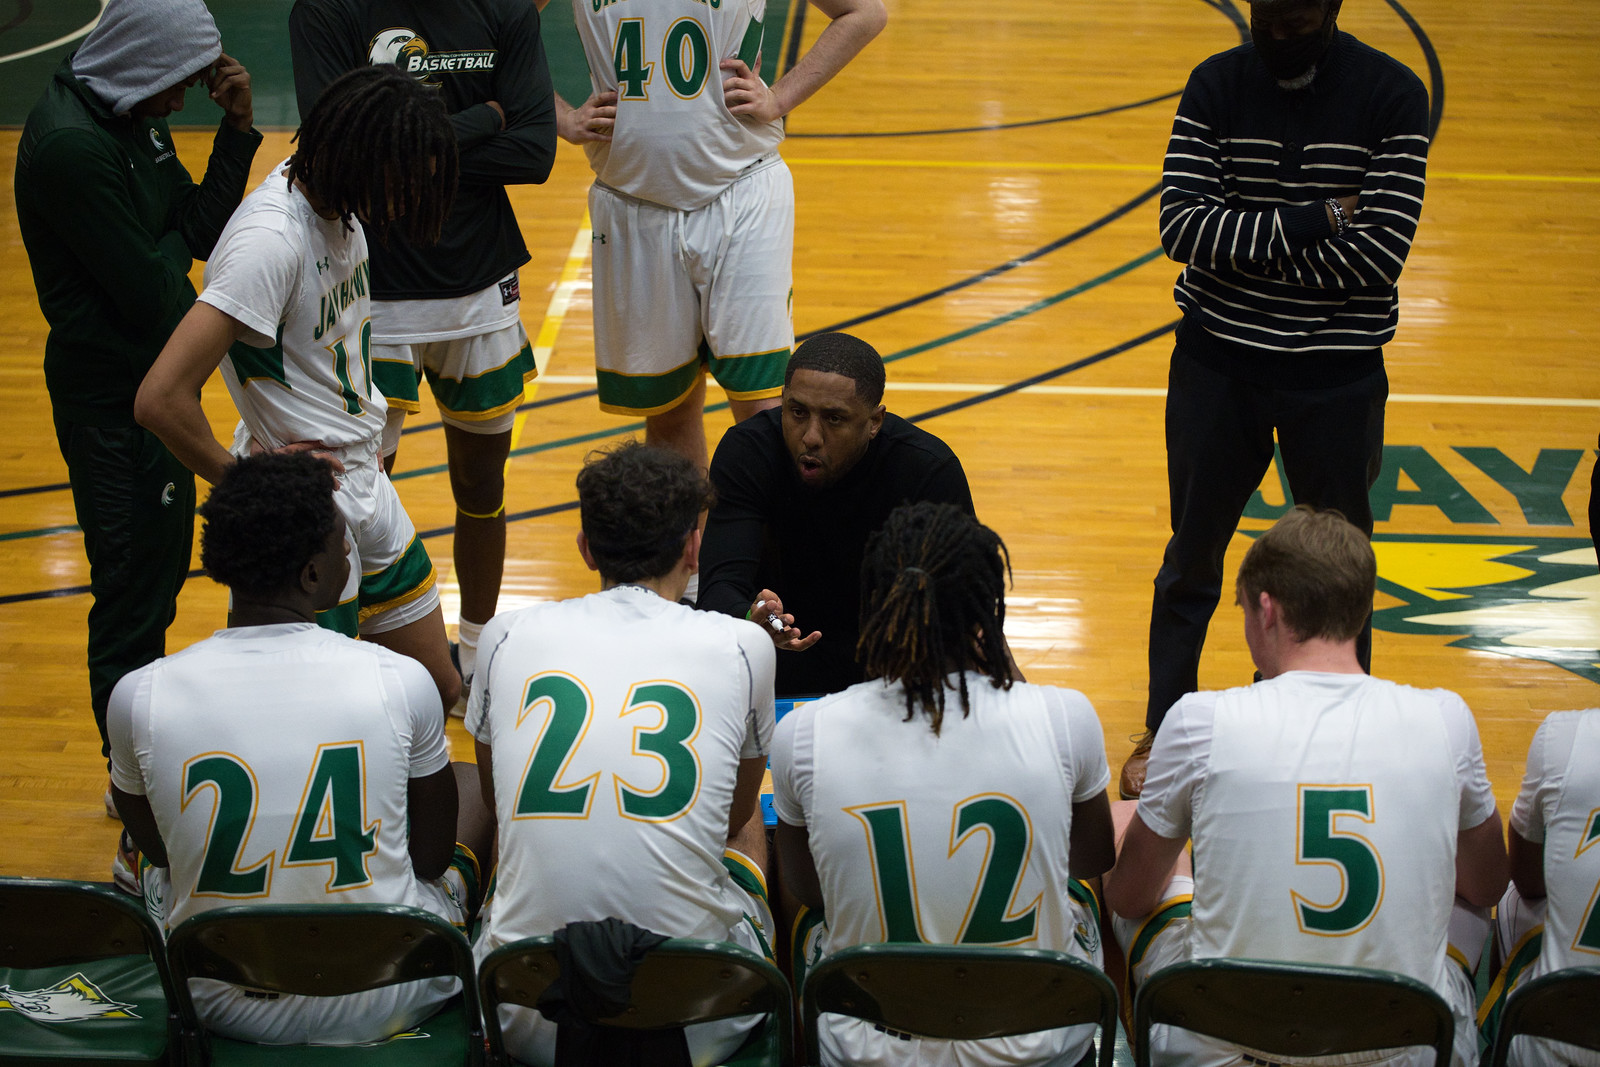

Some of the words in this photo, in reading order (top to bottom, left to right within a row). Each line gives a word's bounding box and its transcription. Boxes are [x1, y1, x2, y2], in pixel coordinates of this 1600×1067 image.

[407, 53, 495, 72] BASKETBALL
[612, 16, 712, 102] 40
[1242, 443, 1600, 528] JAY
[181, 739, 382, 899] 24
[512, 670, 702, 823] 23
[841, 791, 1044, 946] 12
[1290, 783, 1385, 937] 5
